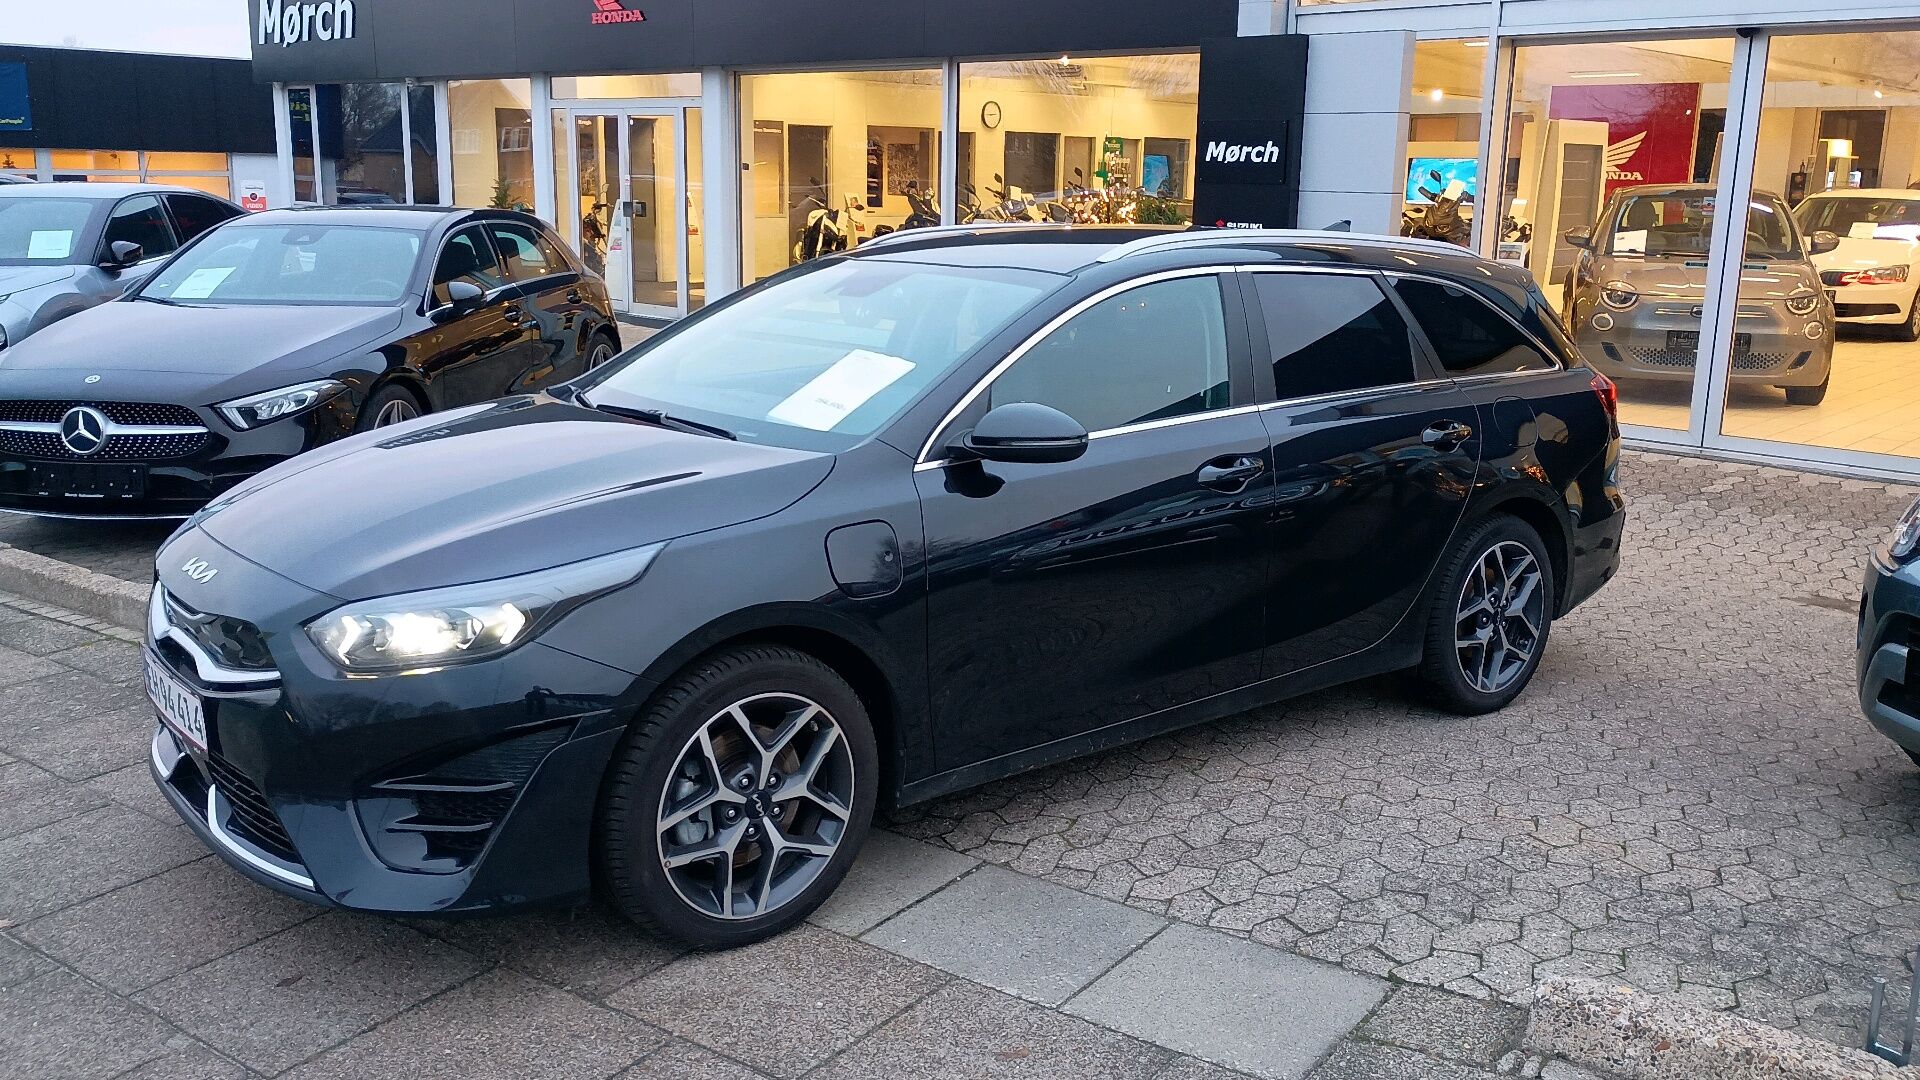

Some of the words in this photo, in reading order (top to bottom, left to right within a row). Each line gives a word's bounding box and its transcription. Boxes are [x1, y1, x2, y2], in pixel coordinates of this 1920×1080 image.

[258, 0, 354, 48] Mørch
[591, 10, 644, 25] HONDA
[1205, 140, 1280, 164] Mørch
[1606, 171, 1644, 181] NDA
